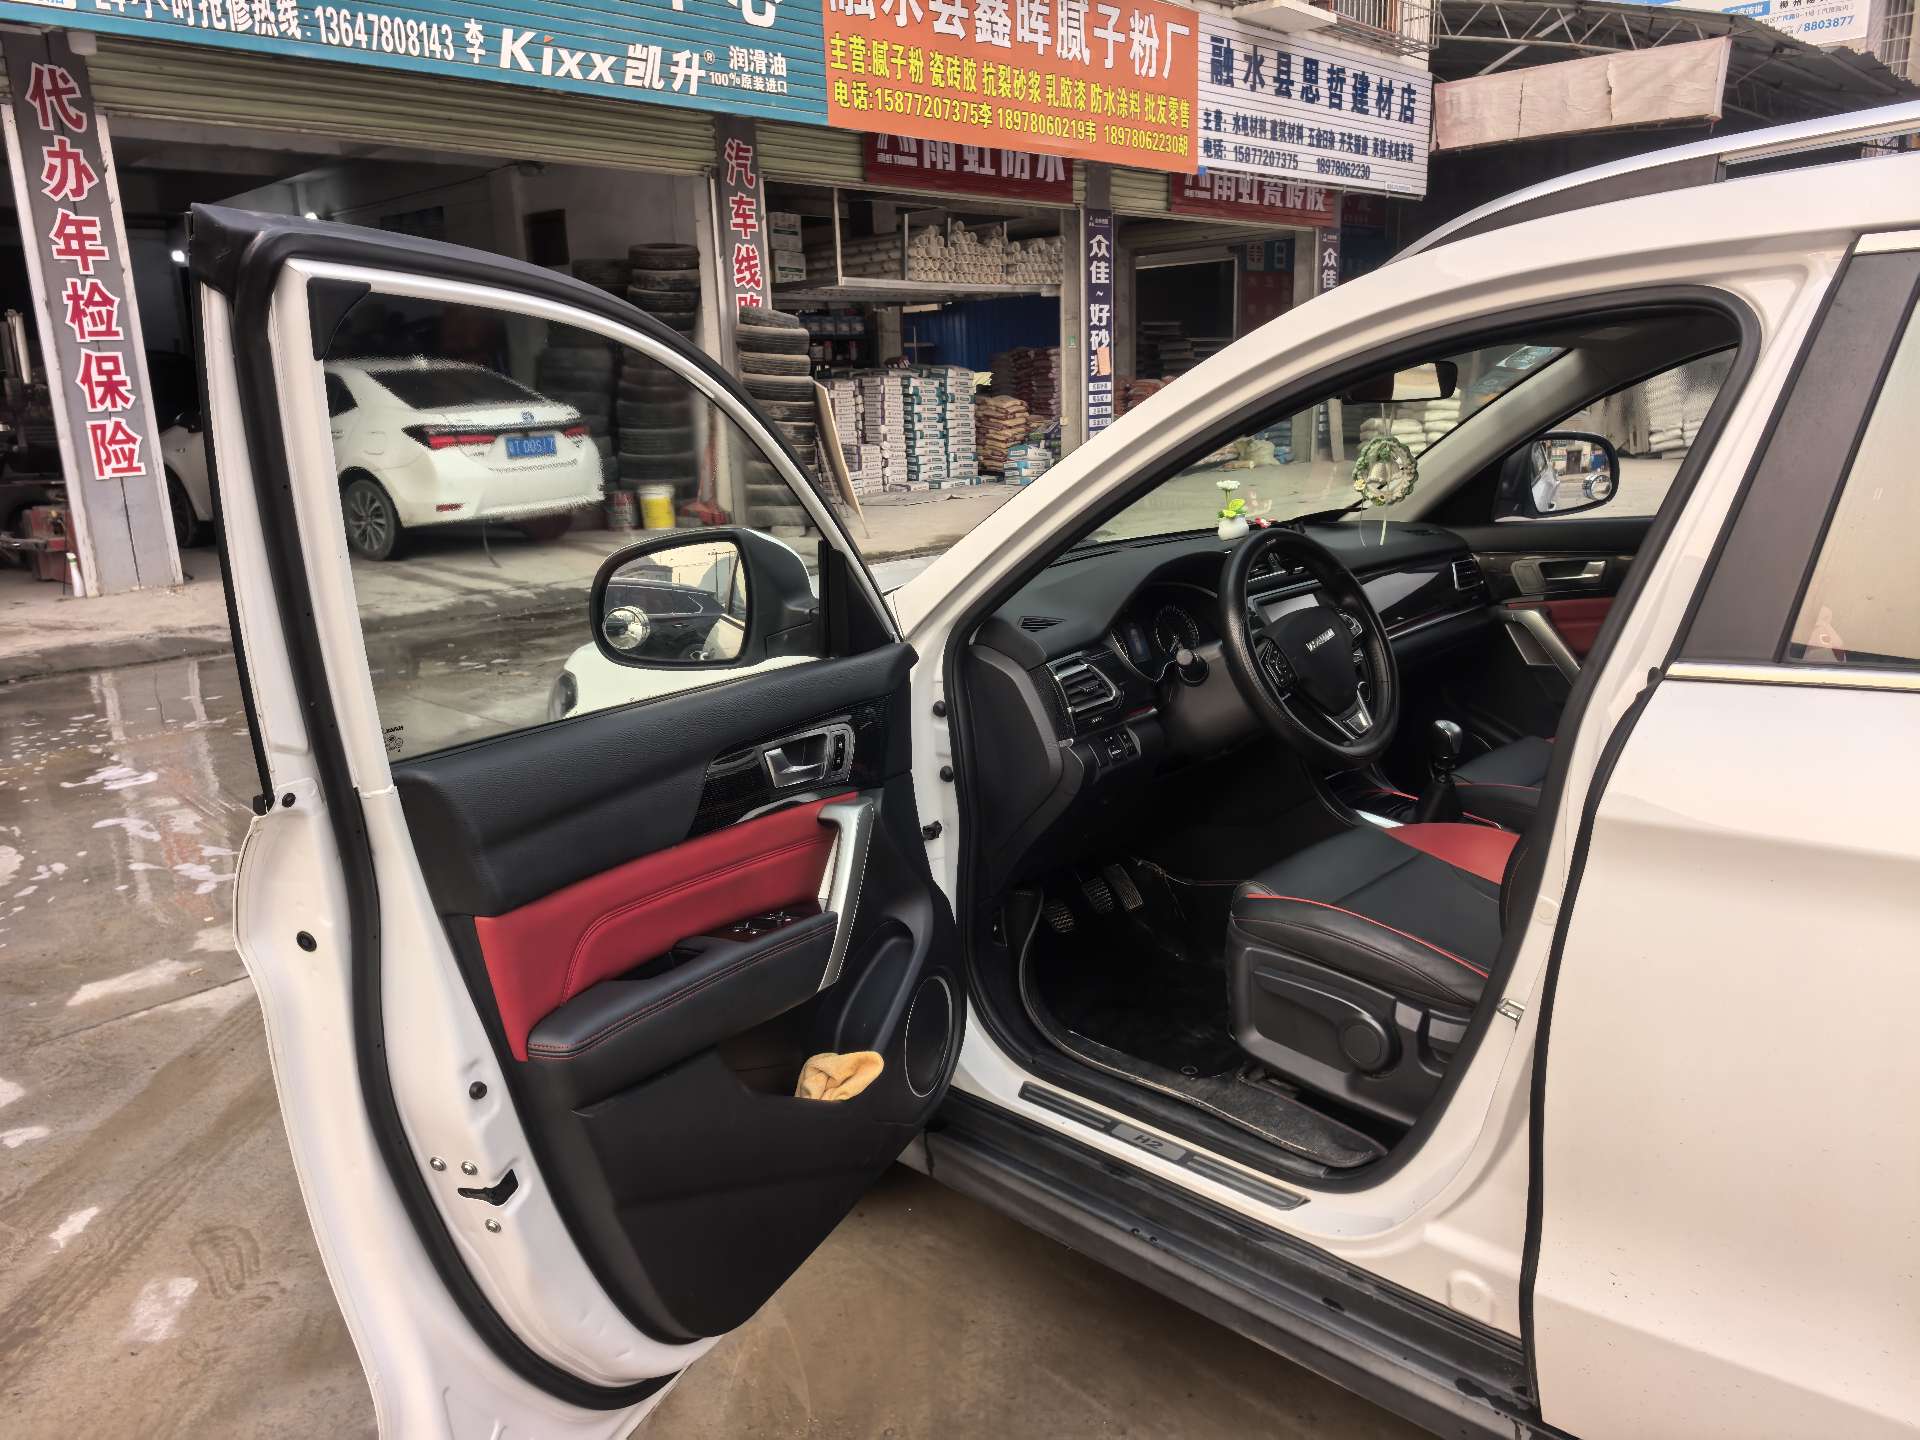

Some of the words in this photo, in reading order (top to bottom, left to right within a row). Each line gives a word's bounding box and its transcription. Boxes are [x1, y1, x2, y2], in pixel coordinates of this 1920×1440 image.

[464, 18, 486, 64] 李
[499, 28, 618, 84] Kixx
[728, 45, 788, 78] 润滑油
[708, 72, 788, 95] 100%原装进口
[929, 51, 977, 94] 瓷砖胶
[982, 61, 1042, 105] 抗裂砂浆
[1045, 73, 1086, 114] 乳胶漆
[1090, 82, 1141, 118] 防水涂料
[1144, 90, 1191, 130] 批发零售
[997, 107, 1097, 144] 18978060219韦
[1103, 122, 1189, 157] 18978062230胡
[26, 62, 146, 480] 代办年检保险
[1133, 1134, 1163, 1149] H2
